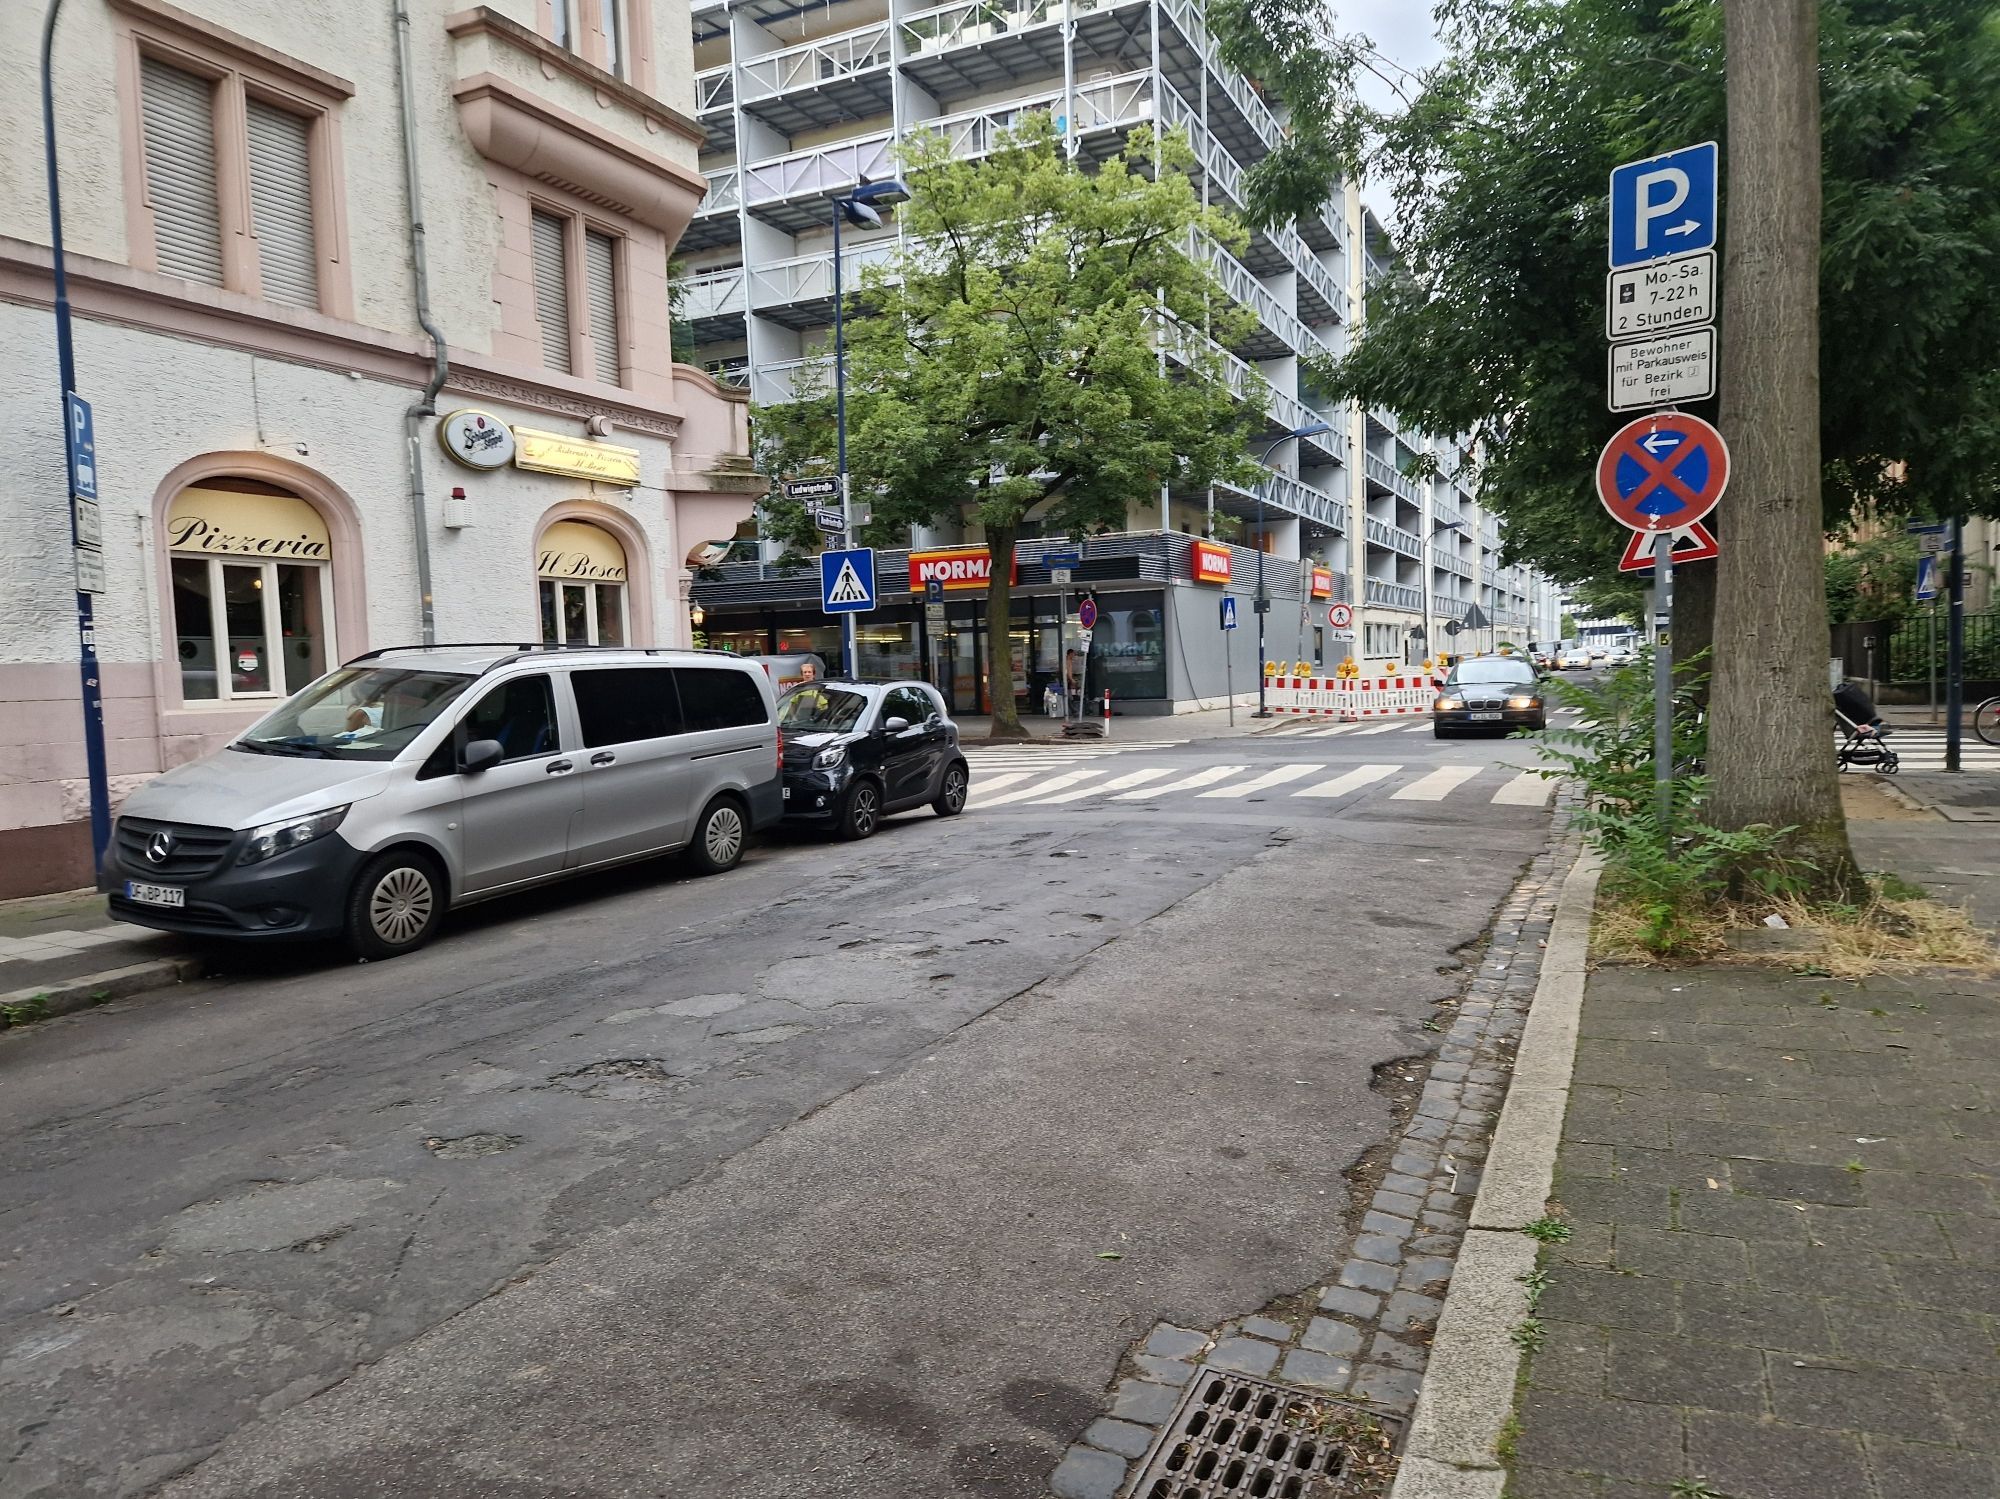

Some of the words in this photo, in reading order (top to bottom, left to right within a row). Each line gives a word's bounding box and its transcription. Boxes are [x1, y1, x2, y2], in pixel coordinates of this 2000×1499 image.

[1635, 167, 1690, 251] P
[1645, 264, 1703, 287] Mo.-Sa.
[1650, 285, 1685, 305] 7-22
[1689, 283, 1698, 297] h
[1619, 316, 1628, 330] 2
[1636, 305, 1703, 327] Stunden
[1630, 340, 1692, 359] Bewohner
[1616, 362, 1633, 373] mit
[1637, 350, 1708, 370] Parkausweis
[1622, 376, 1639, 388] für
[1645, 368, 1683, 384] Bezirk
[1650, 385, 1671, 397] frei
[73, 403, 86, 443] P
[791, 482, 832, 494] Ludwigstraße
[168, 516, 325, 557] Pizzeria
[538, 550, 566, 574] Il
[564, 552, 625, 579] Bosco
[1202, 552, 1228, 574] NORMA
[163, 889, 182, 904] 117
